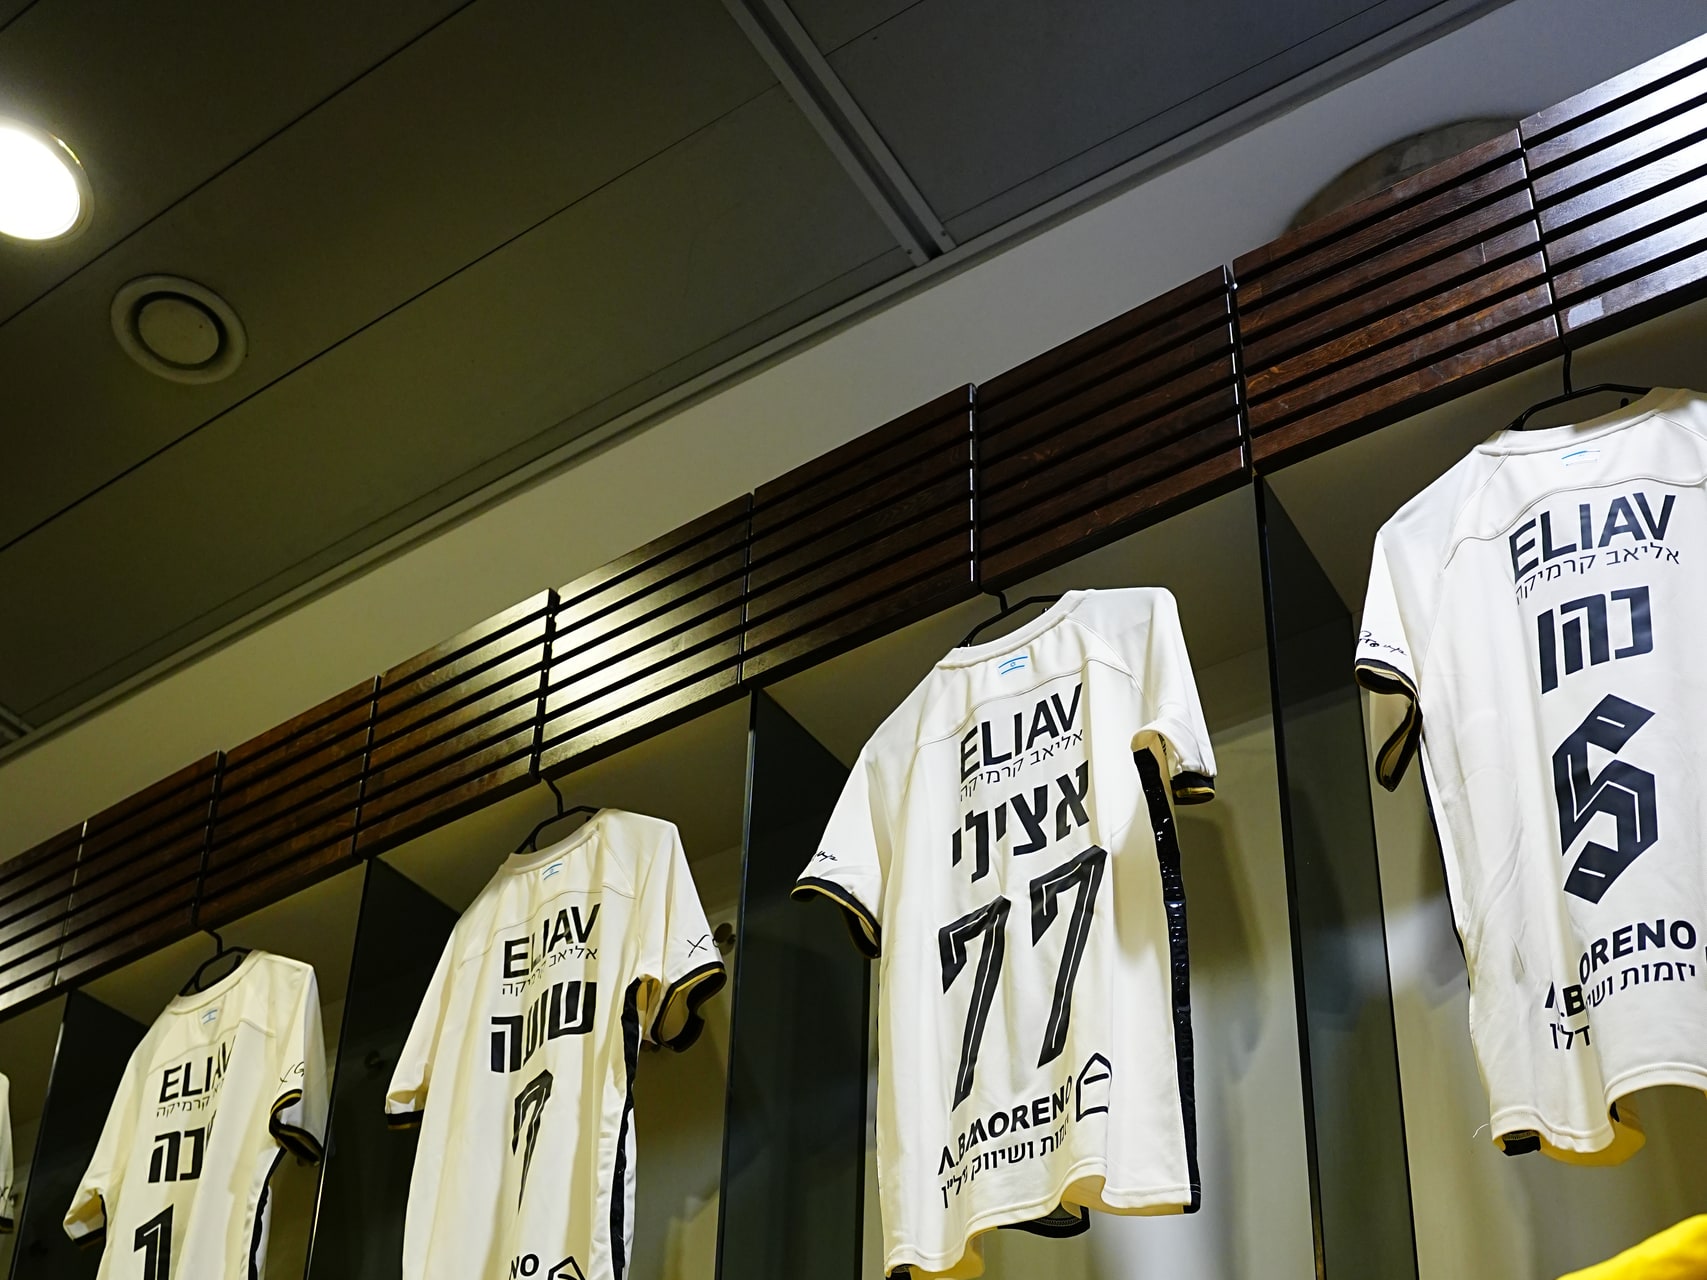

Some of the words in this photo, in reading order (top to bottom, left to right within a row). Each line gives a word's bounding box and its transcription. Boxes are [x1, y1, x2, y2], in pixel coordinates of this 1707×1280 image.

[1508, 491, 1677, 585] ELIAV
[1606, 541, 1681, 566] אליאב
[960, 681, 1084, 785] ELIAV
[1030, 728, 1084, 766] אליאב
[960, 757, 1025, 802] קרמיקה
[502, 902, 602, 979] ELIAV
[938, 844, 1108, 1113] 77
